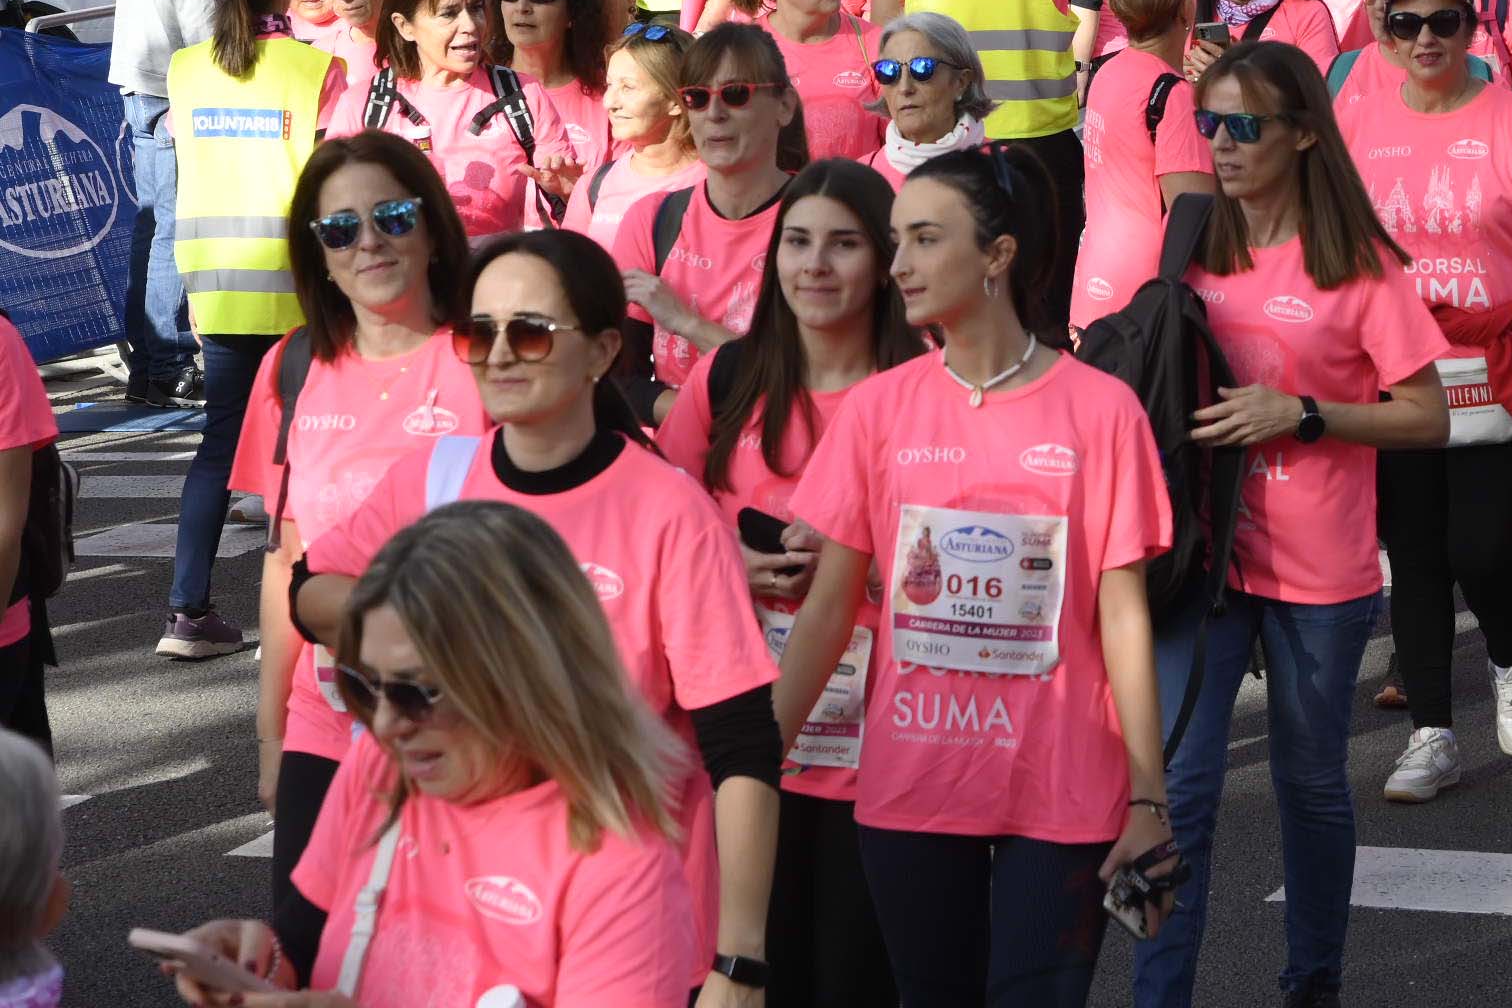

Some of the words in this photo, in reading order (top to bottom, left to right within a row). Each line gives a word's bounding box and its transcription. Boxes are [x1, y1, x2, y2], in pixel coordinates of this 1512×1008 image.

[193, 116, 280, 131] VOLUNTARIS
[1368, 146, 1411, 159] OYSHO
[299, 415, 356, 431] OYSHO
[897, 447, 966, 465] OYSHO
[947, 536, 1009, 556] ASTURIANA
[947, 573, 1004, 599] 016
[951, 603, 994, 619] 15401
[909, 618, 951, 632] CARRERA
[953, 622, 965, 634] DE
[967, 625, 981, 635] LA
[984, 626, 1017, 638] MUJER
[907, 639, 950, 656] OYSHO
[992, 648, 1044, 663] Santander
[892, 690, 1013, 734] SUMA
[800, 743, 850, 755] Santander
